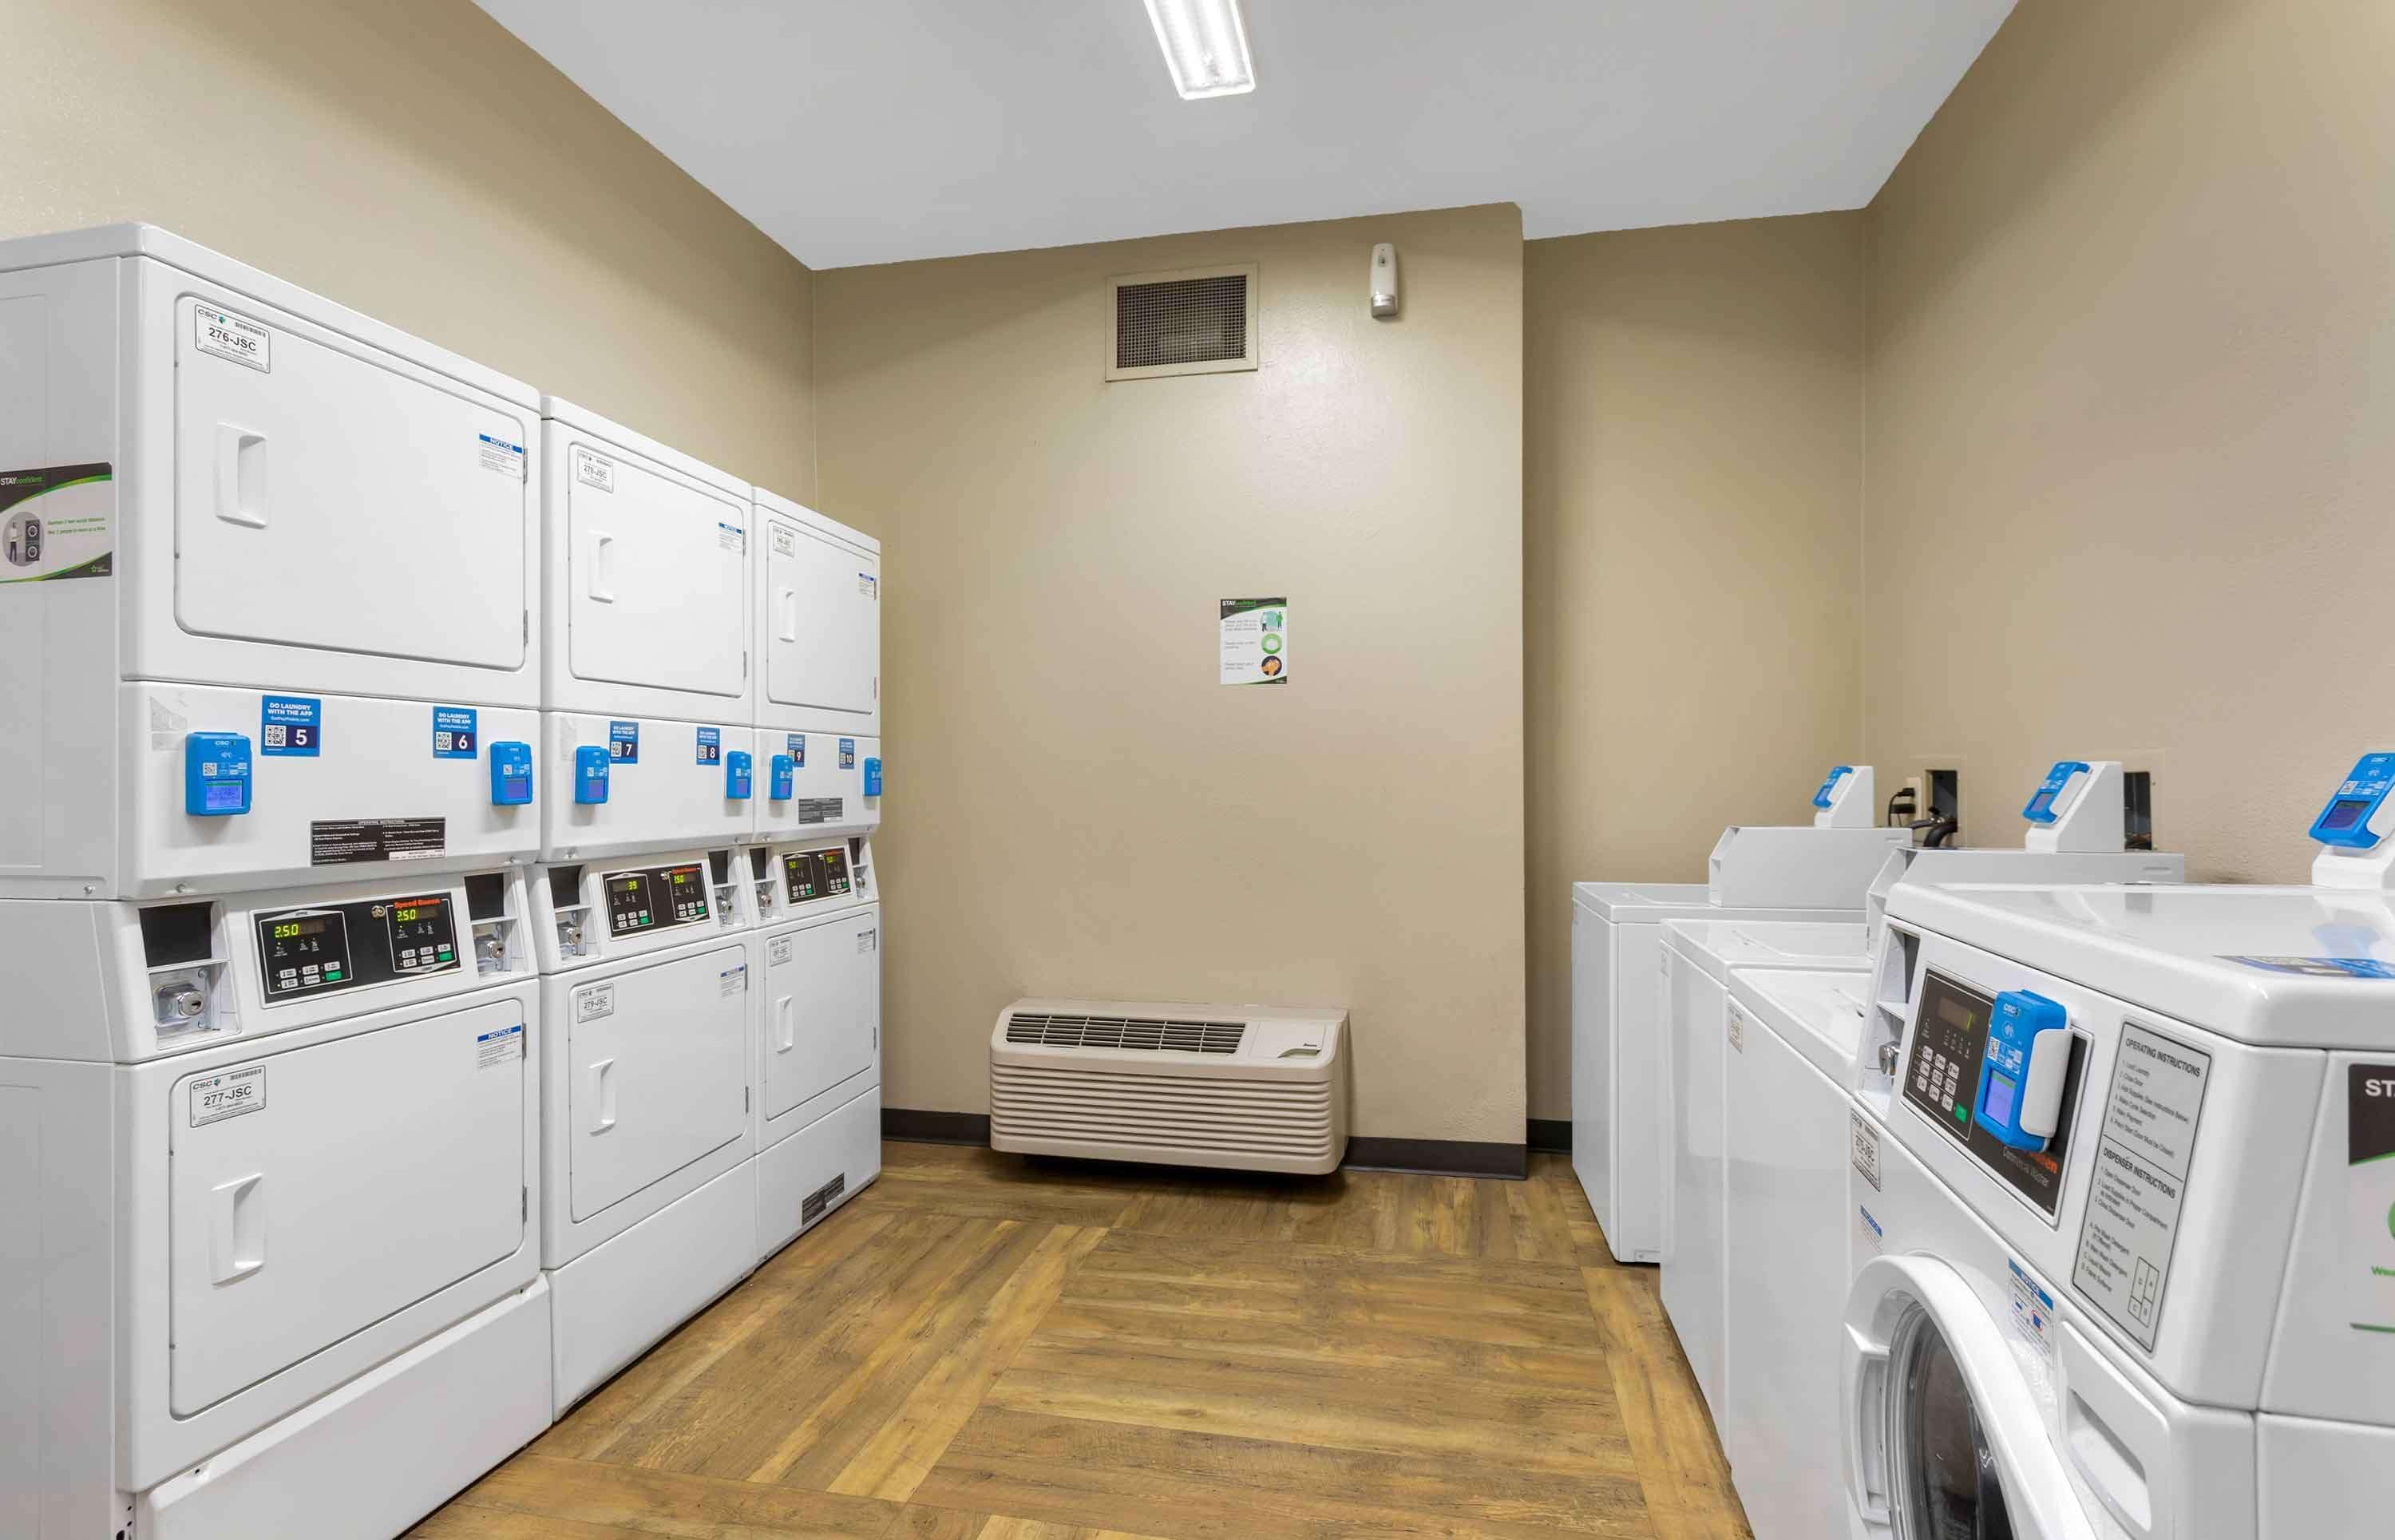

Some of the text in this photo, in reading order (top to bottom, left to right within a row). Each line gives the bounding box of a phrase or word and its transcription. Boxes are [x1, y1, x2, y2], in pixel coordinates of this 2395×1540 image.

[208, 327, 256, 351] 276-JSC
[295, 728, 307, 746] 5
[458, 734, 468, 750] 6
[625, 743, 633, 756] 7
[710, 746, 716, 758] 8
[797, 750, 802, 762] 9
[275, 924, 299, 938] 2.50
[2126, 1038, 2201, 1078] OPERATING INSTRUCTIONS
[204, 1086, 252, 1106] 277-JSC
[2365, 1079, 2395, 1098] ST
[2104, 1147, 2175, 1198] DISPENSER INSTRUCTIONS
